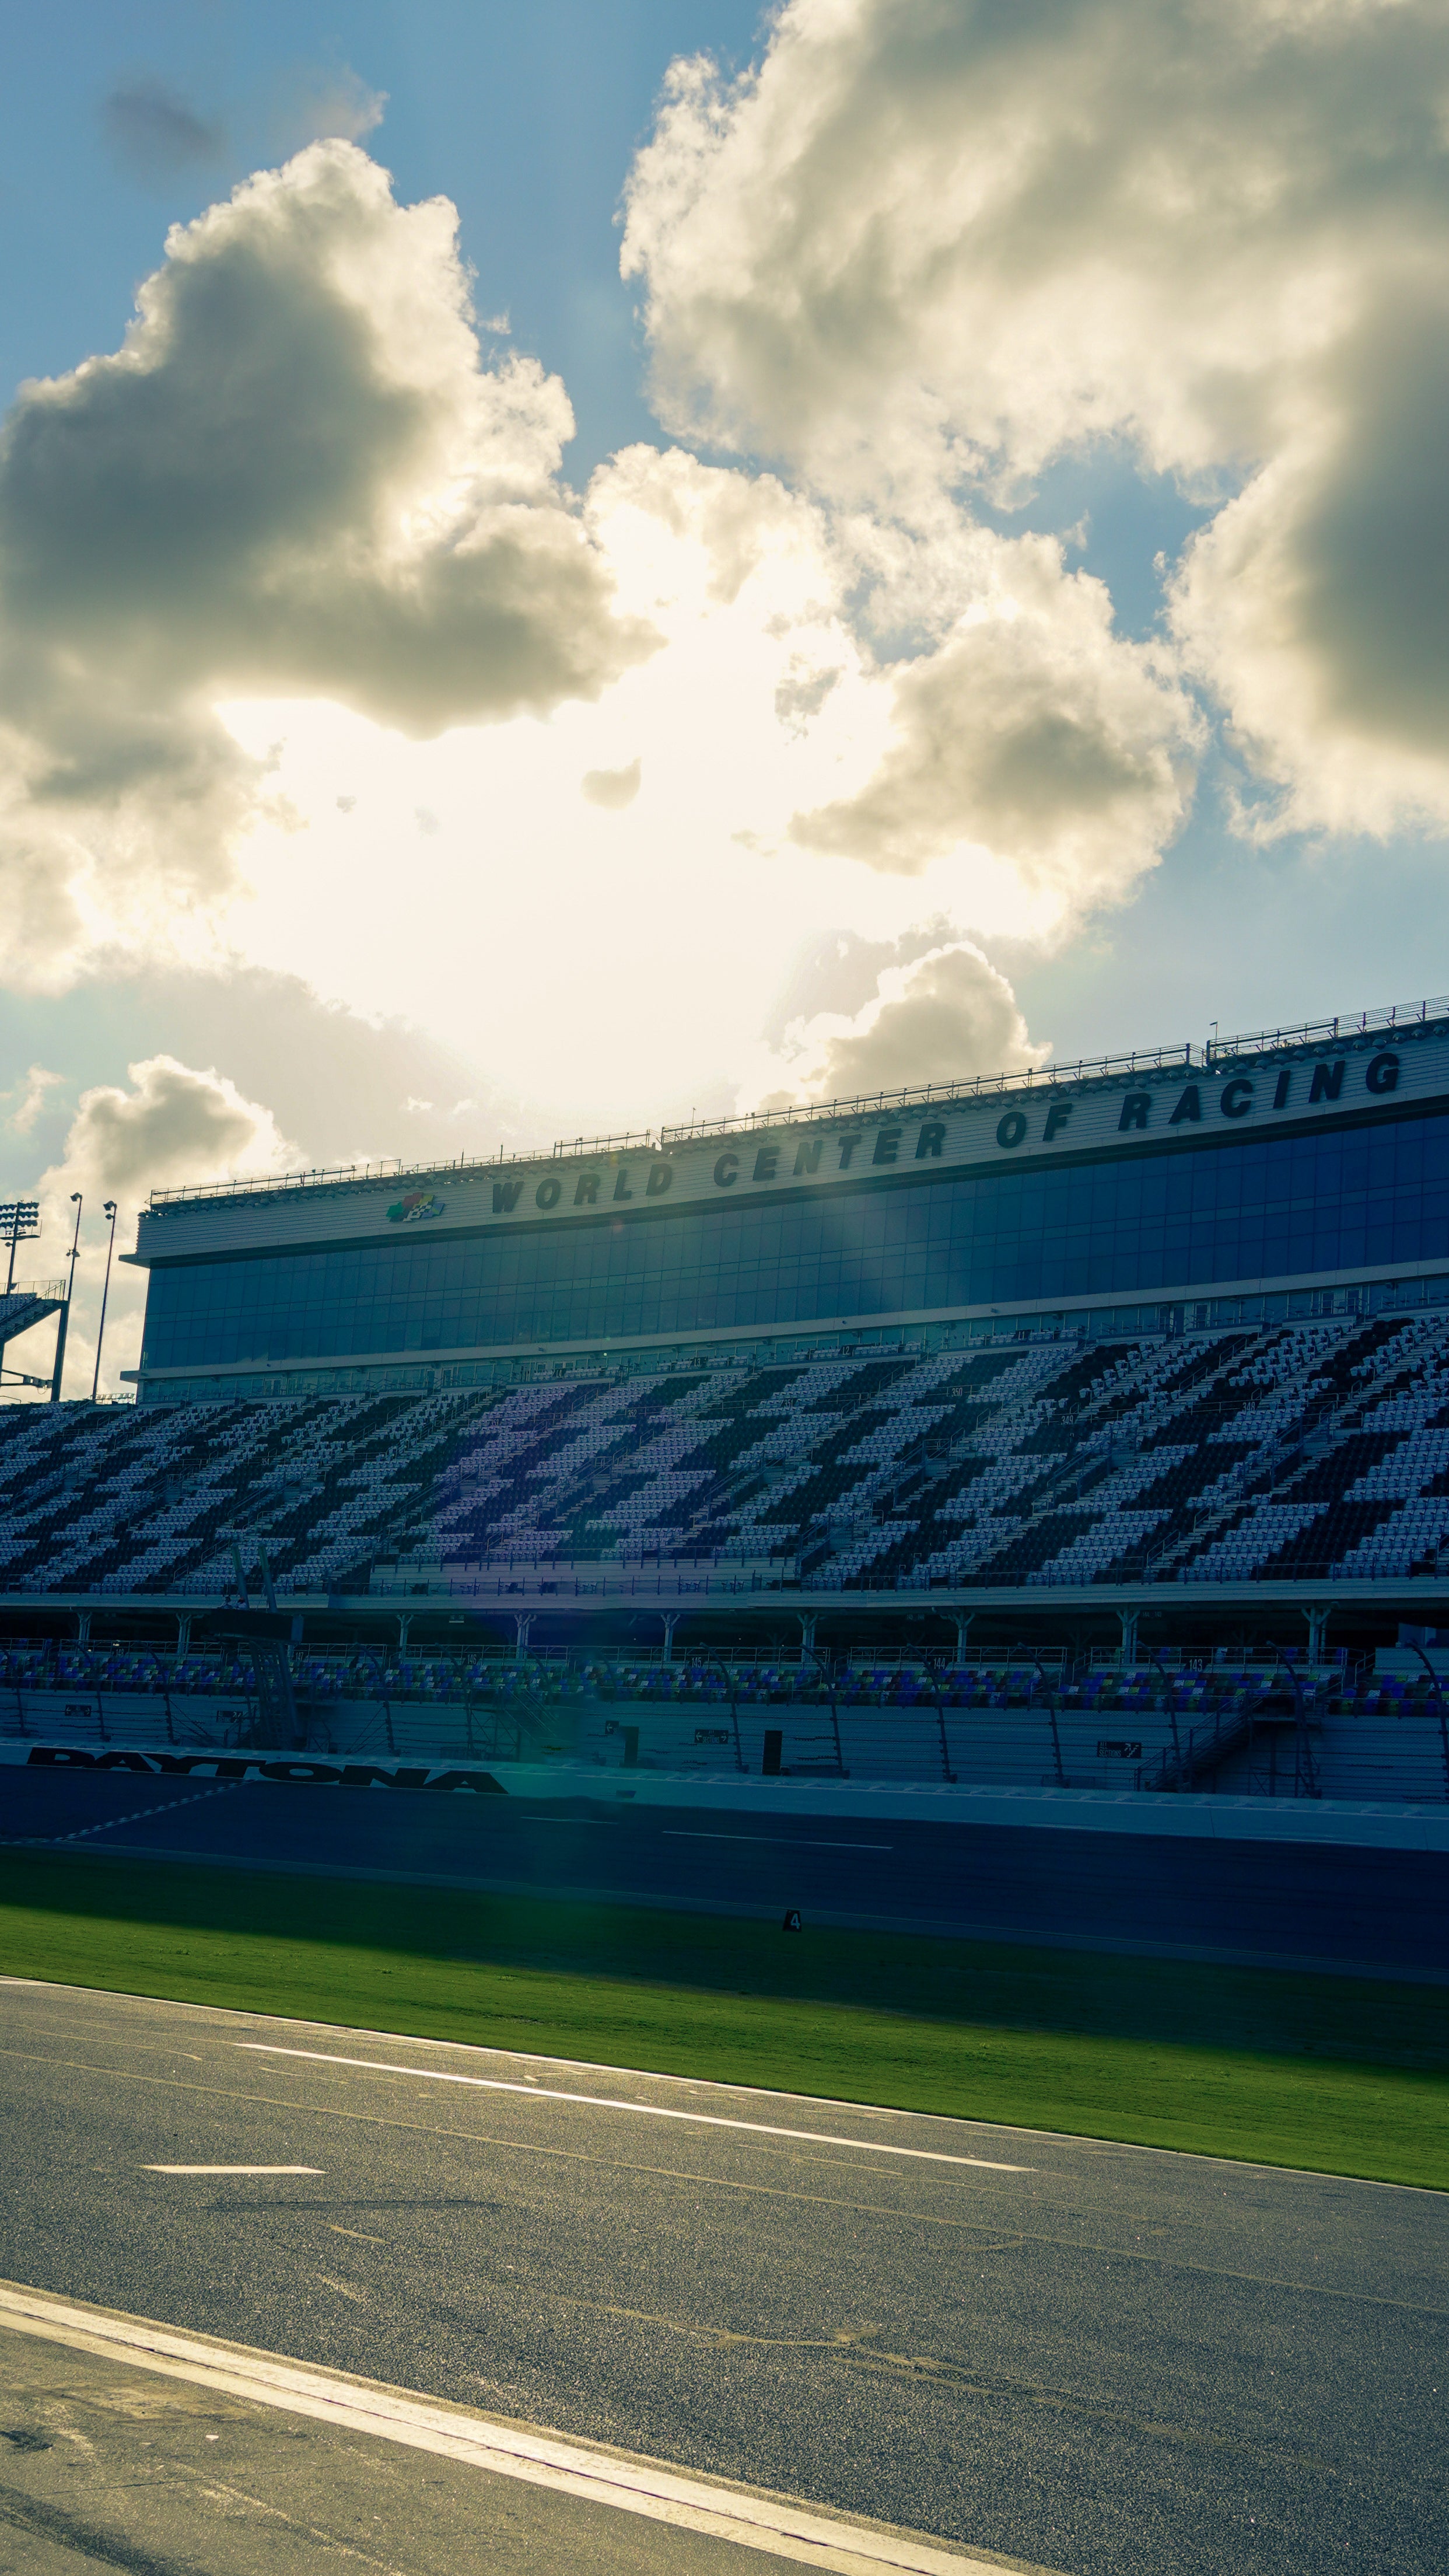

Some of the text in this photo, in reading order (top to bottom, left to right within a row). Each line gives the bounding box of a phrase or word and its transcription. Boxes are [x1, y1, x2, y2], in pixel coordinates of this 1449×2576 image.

[492, 1053, 1399, 1213] WORLD CENTER OF RACING
[843, 1346, 850, 1355] L2
[951, 1387, 963, 1397] 350
[1242, 1401, 1255, 1411] 348
[1061, 1415, 1073, 1424] 349
[468, 1654, 477, 1665] 146
[692, 1657, 702, 1668] 145
[933, 1658, 945, 1669] 144
[1189, 1659, 1202, 1672] 143
[26, 1747, 509, 1795] DAYTONA
[790, 1913, 800, 1929] 4
